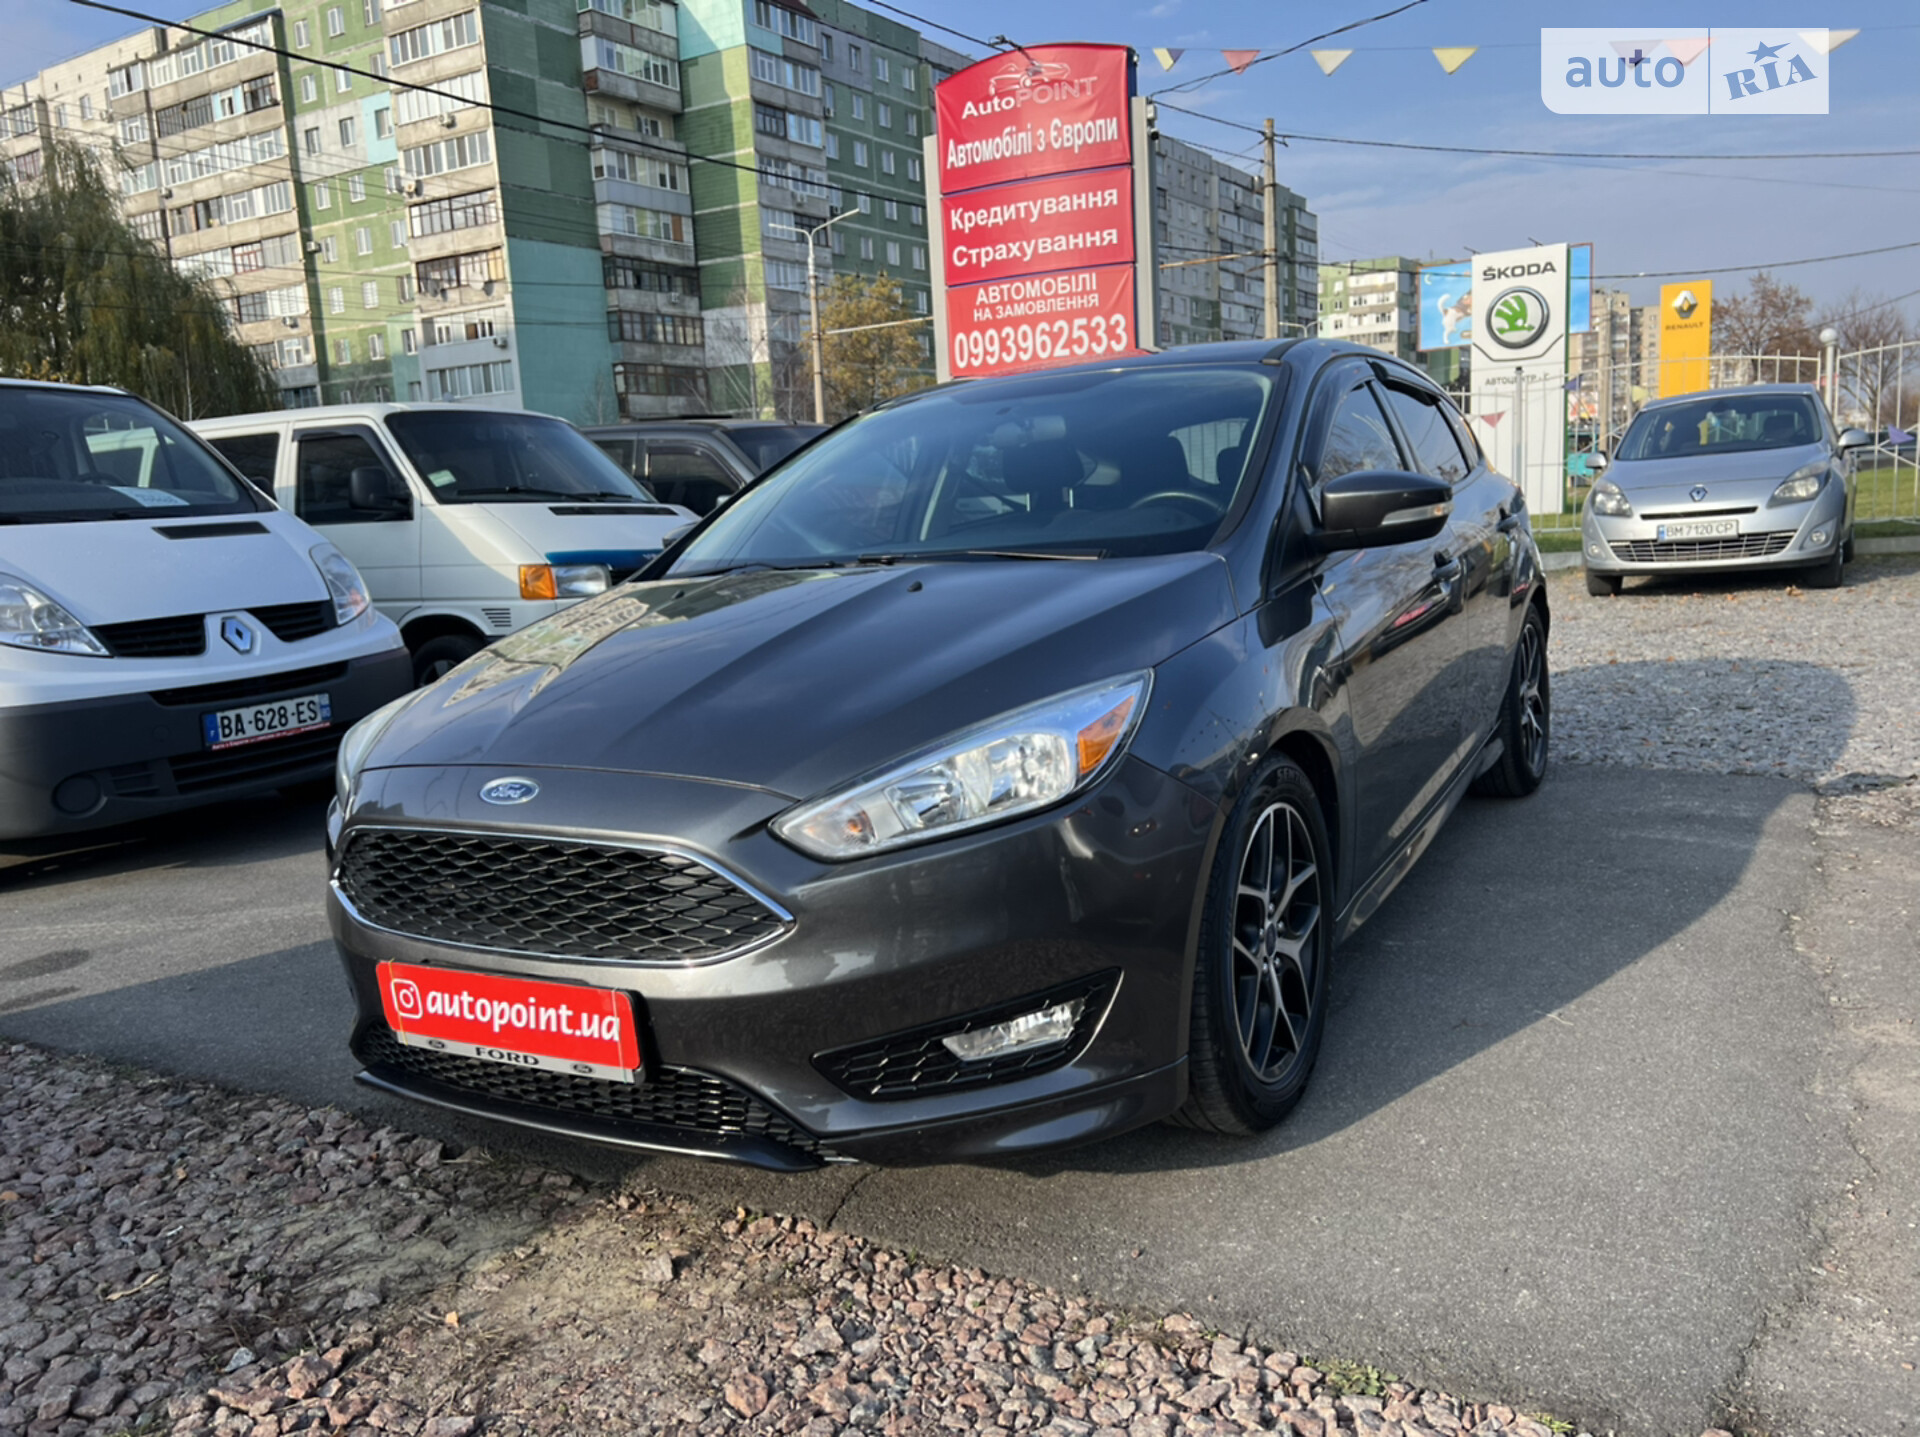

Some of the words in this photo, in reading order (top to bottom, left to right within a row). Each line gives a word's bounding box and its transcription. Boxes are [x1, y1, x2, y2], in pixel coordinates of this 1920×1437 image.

[946, 123, 1033, 169] Автомобілі
[1036, 129, 1046, 152] з
[1049, 117, 1119, 153] Європи
[950, 188, 1119, 234] Кредитування
[952, 227, 1119, 268] Страхування
[975, 272, 1097, 306] АВТОМОБІЛІ
[1482, 261, 1557, 281] ŠKODA
[973, 307, 994, 322] НА
[995, 293, 1100, 319] ЗАМОВЛЕННЯ
[1665, 321, 1704, 331] RENAULT
[954, 313, 1129, 369] 0993962533
[425, 989, 621, 1042] autopoint.ua
[474, 1046, 541, 1066] FORD
